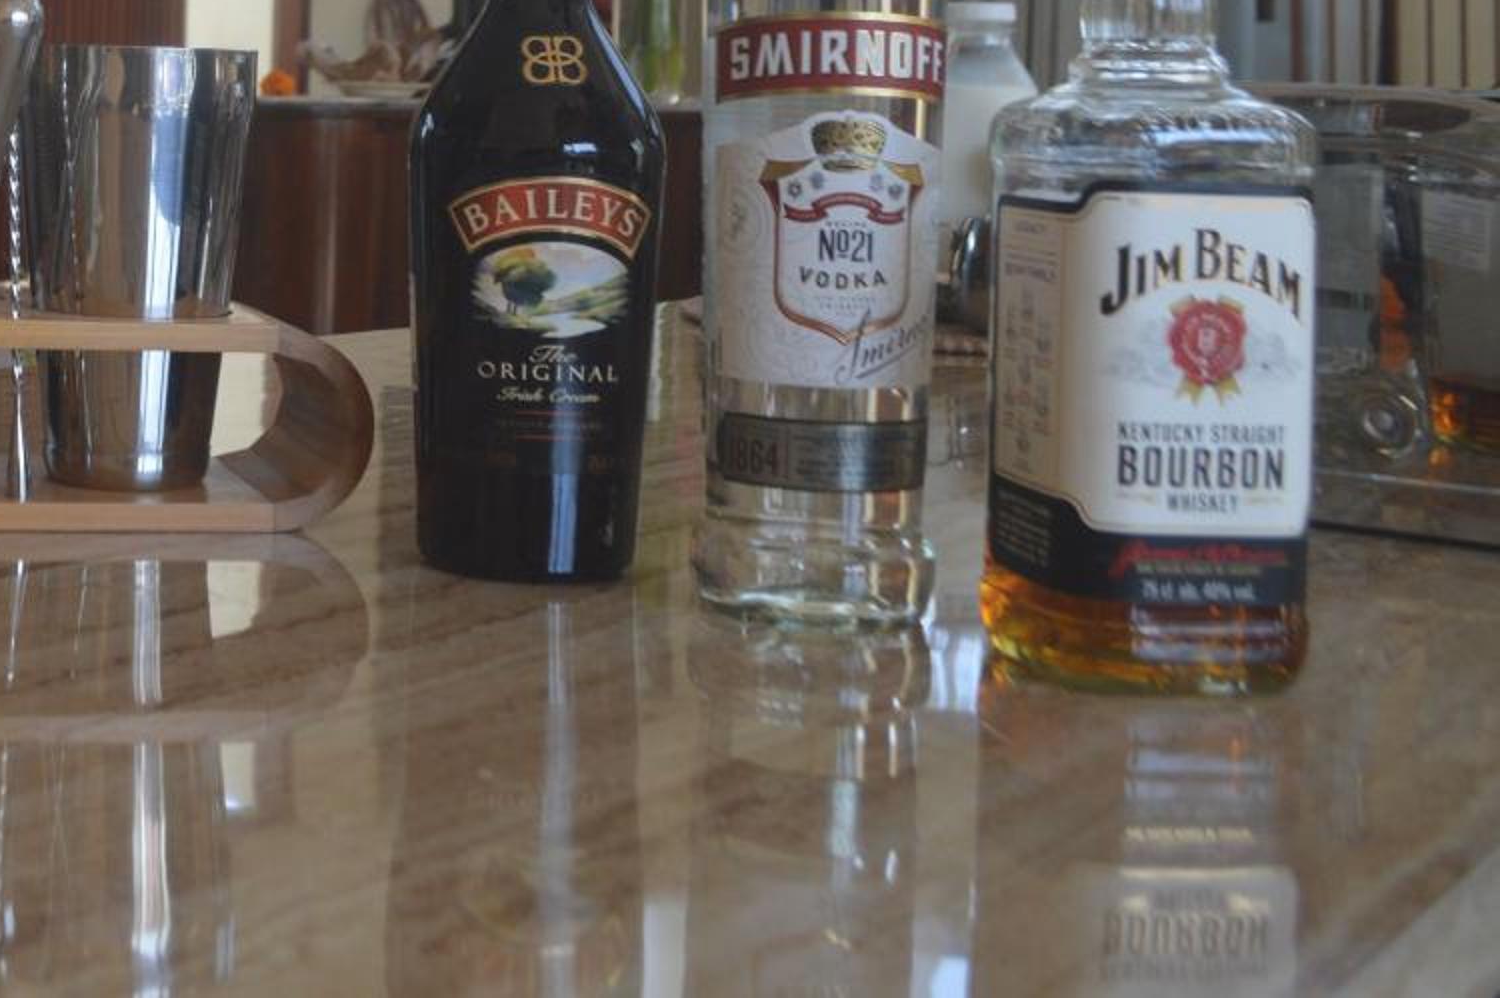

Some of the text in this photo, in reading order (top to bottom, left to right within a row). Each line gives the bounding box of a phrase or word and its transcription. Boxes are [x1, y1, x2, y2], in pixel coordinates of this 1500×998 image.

[730, 28, 945, 84] SMIRNOFF
[463, 188, 643, 237] BAILEYS
[799, 266, 888, 290] VODKA
[1100, 227, 1302, 327] JIM BEAM
[528, 344, 579, 364] The
[477, 361, 619, 383] ORIGINAL
[1117, 422, 1286, 444] KENTUCKY STRAIGHT
[1117, 445, 1285, 490] BOURBON
[1166, 492, 1239, 513] WHISKEY
